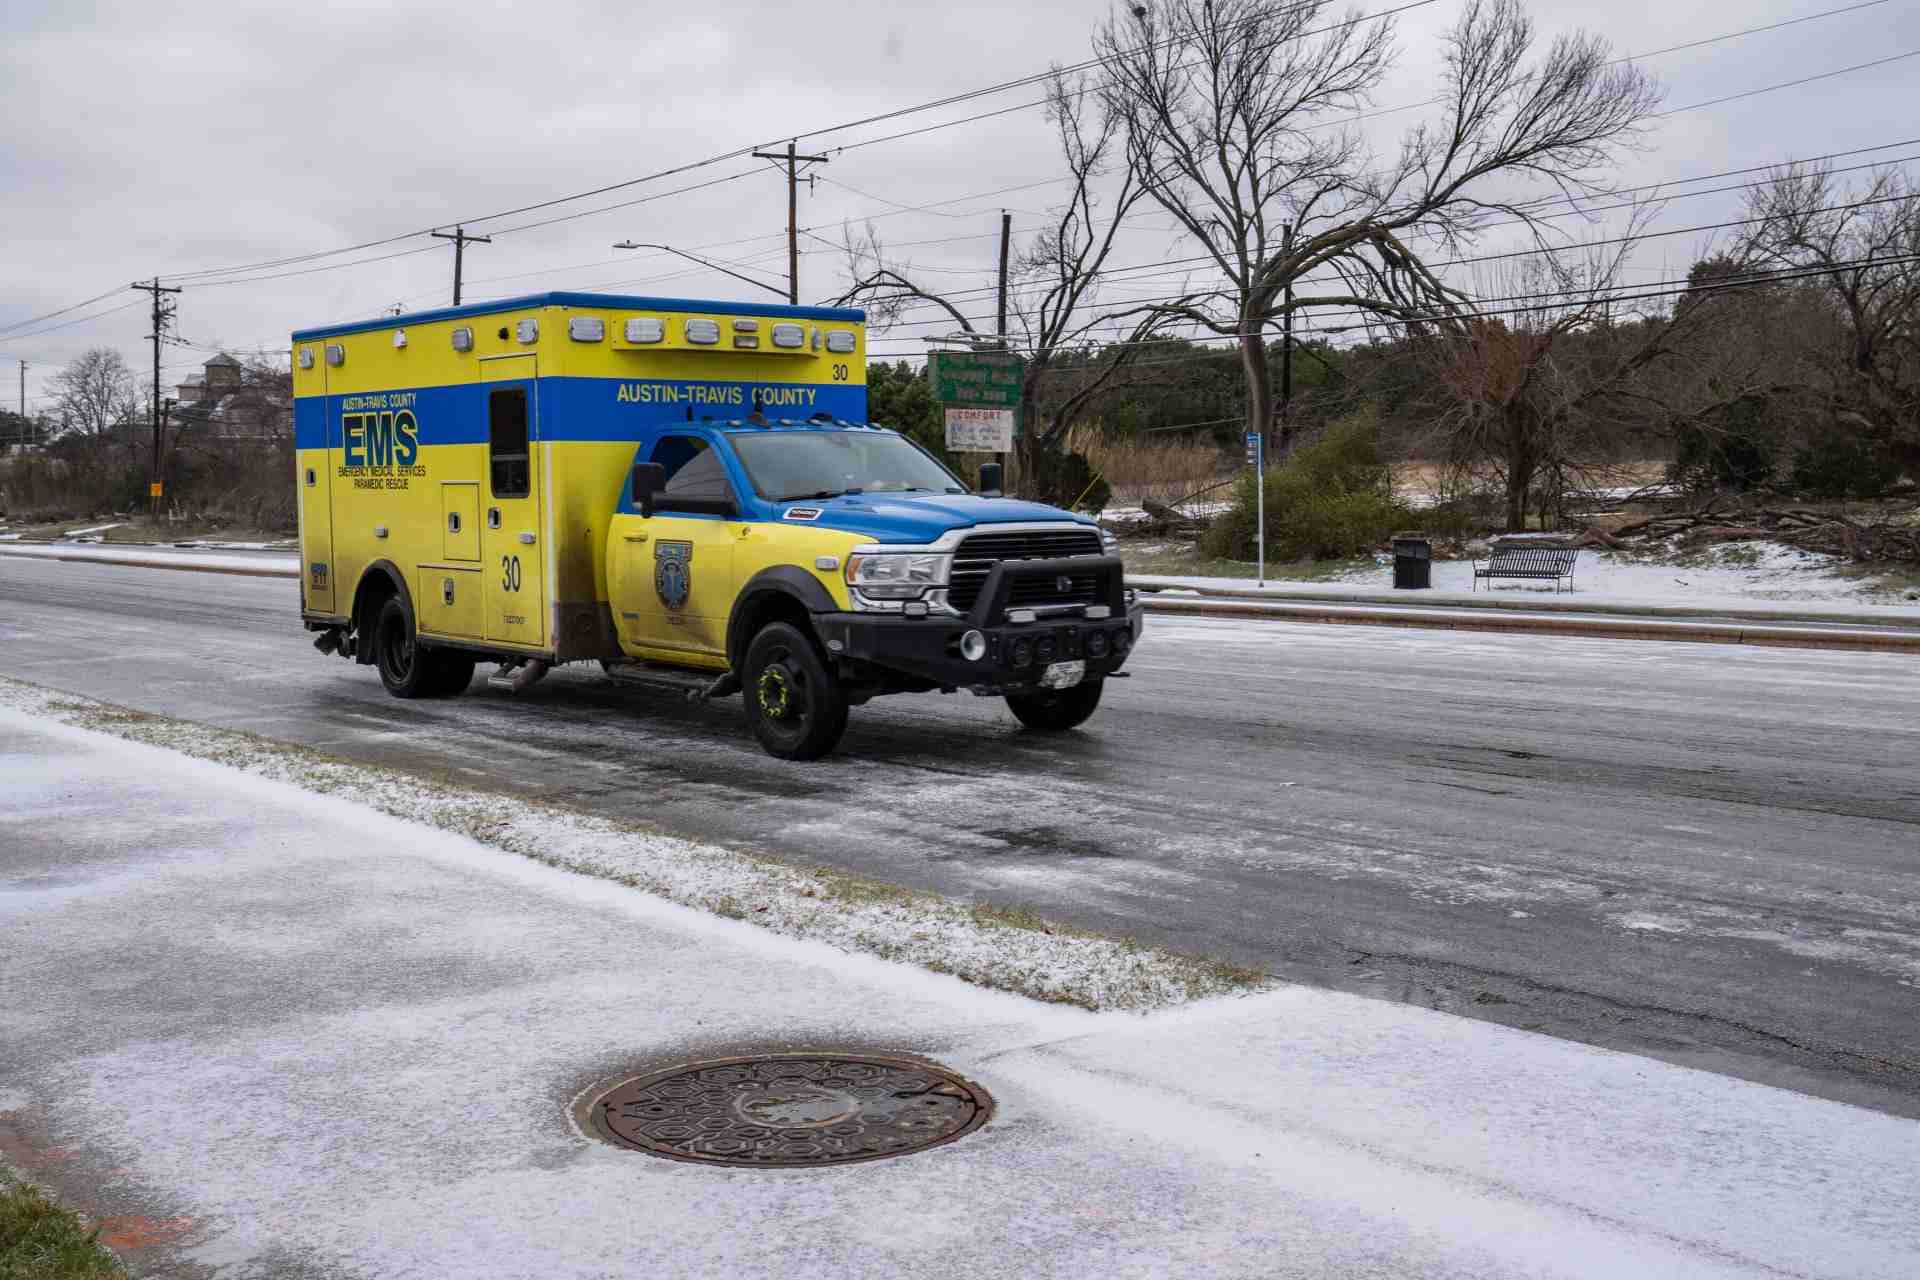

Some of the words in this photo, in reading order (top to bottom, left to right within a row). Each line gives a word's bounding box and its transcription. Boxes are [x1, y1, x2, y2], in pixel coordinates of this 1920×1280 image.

[832, 364, 848, 381] 30
[390, 391, 416, 408] COUNTY
[617, 384, 743, 405] AUSTIN-TRAVIS
[751, 387, 816, 406] COUNTY
[342, 409, 418, 467] EMS
[502, 555, 520, 592] 30
